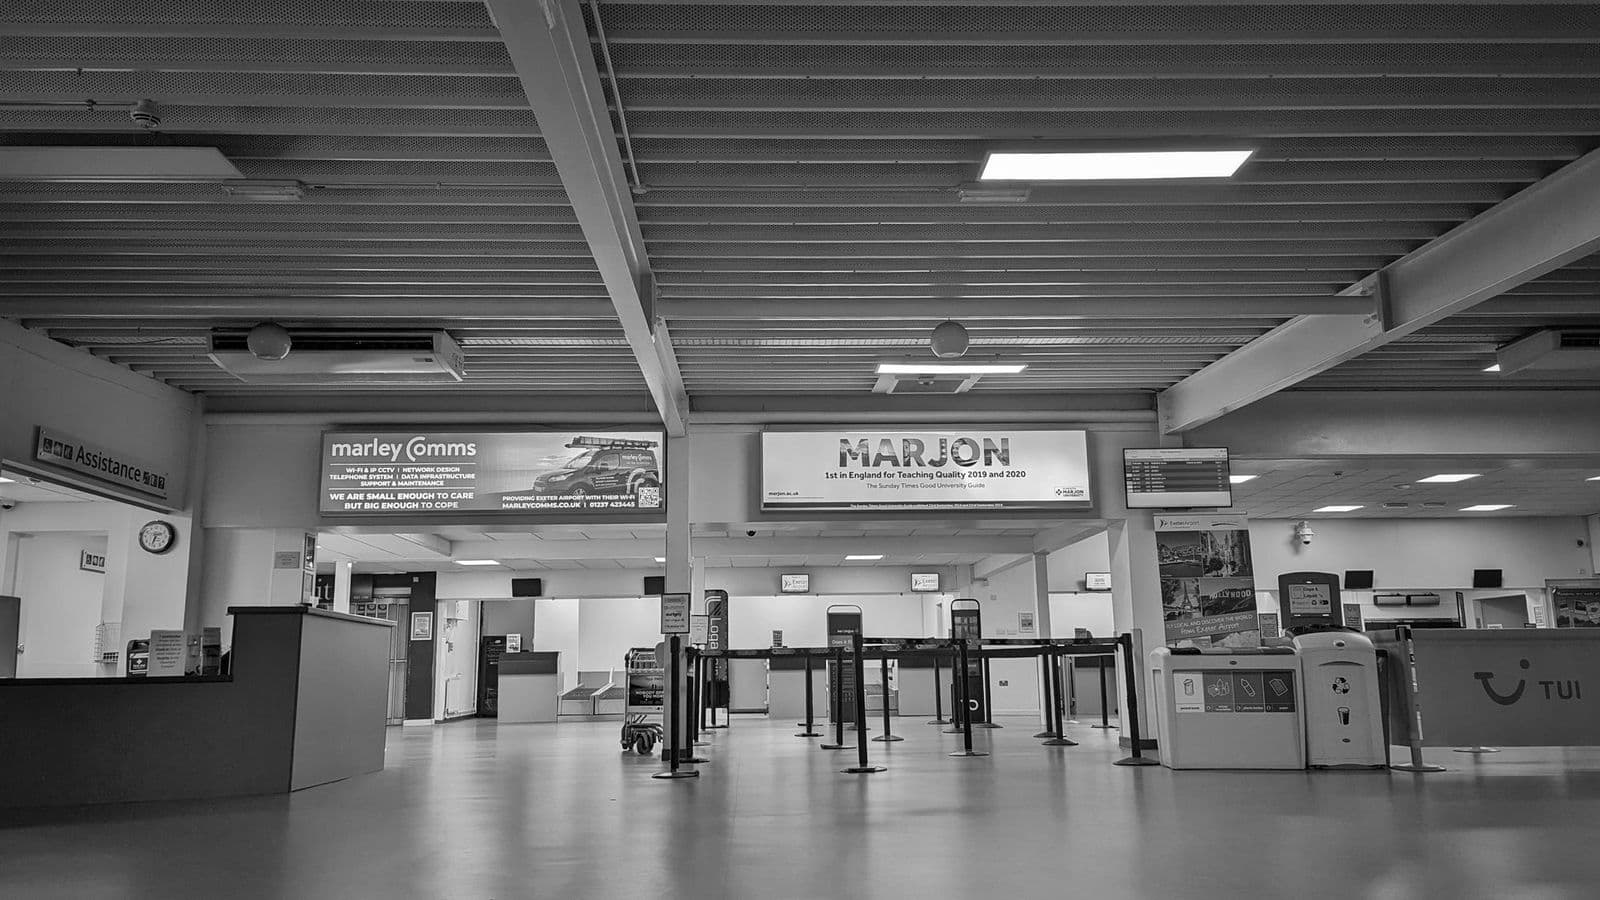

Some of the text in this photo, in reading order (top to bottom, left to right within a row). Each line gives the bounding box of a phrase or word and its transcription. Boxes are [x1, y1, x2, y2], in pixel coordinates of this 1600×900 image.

[332, 436, 476, 462] marley Comms
[839, 438, 1010, 468] MARJON
[76, 445, 141, 482] Assistance
[849, 472, 882, 480] England
[898, 471, 934, 480] Teaching
[936, 471, 966, 480] Quality
[1538, 680, 1581, 699] TUI
